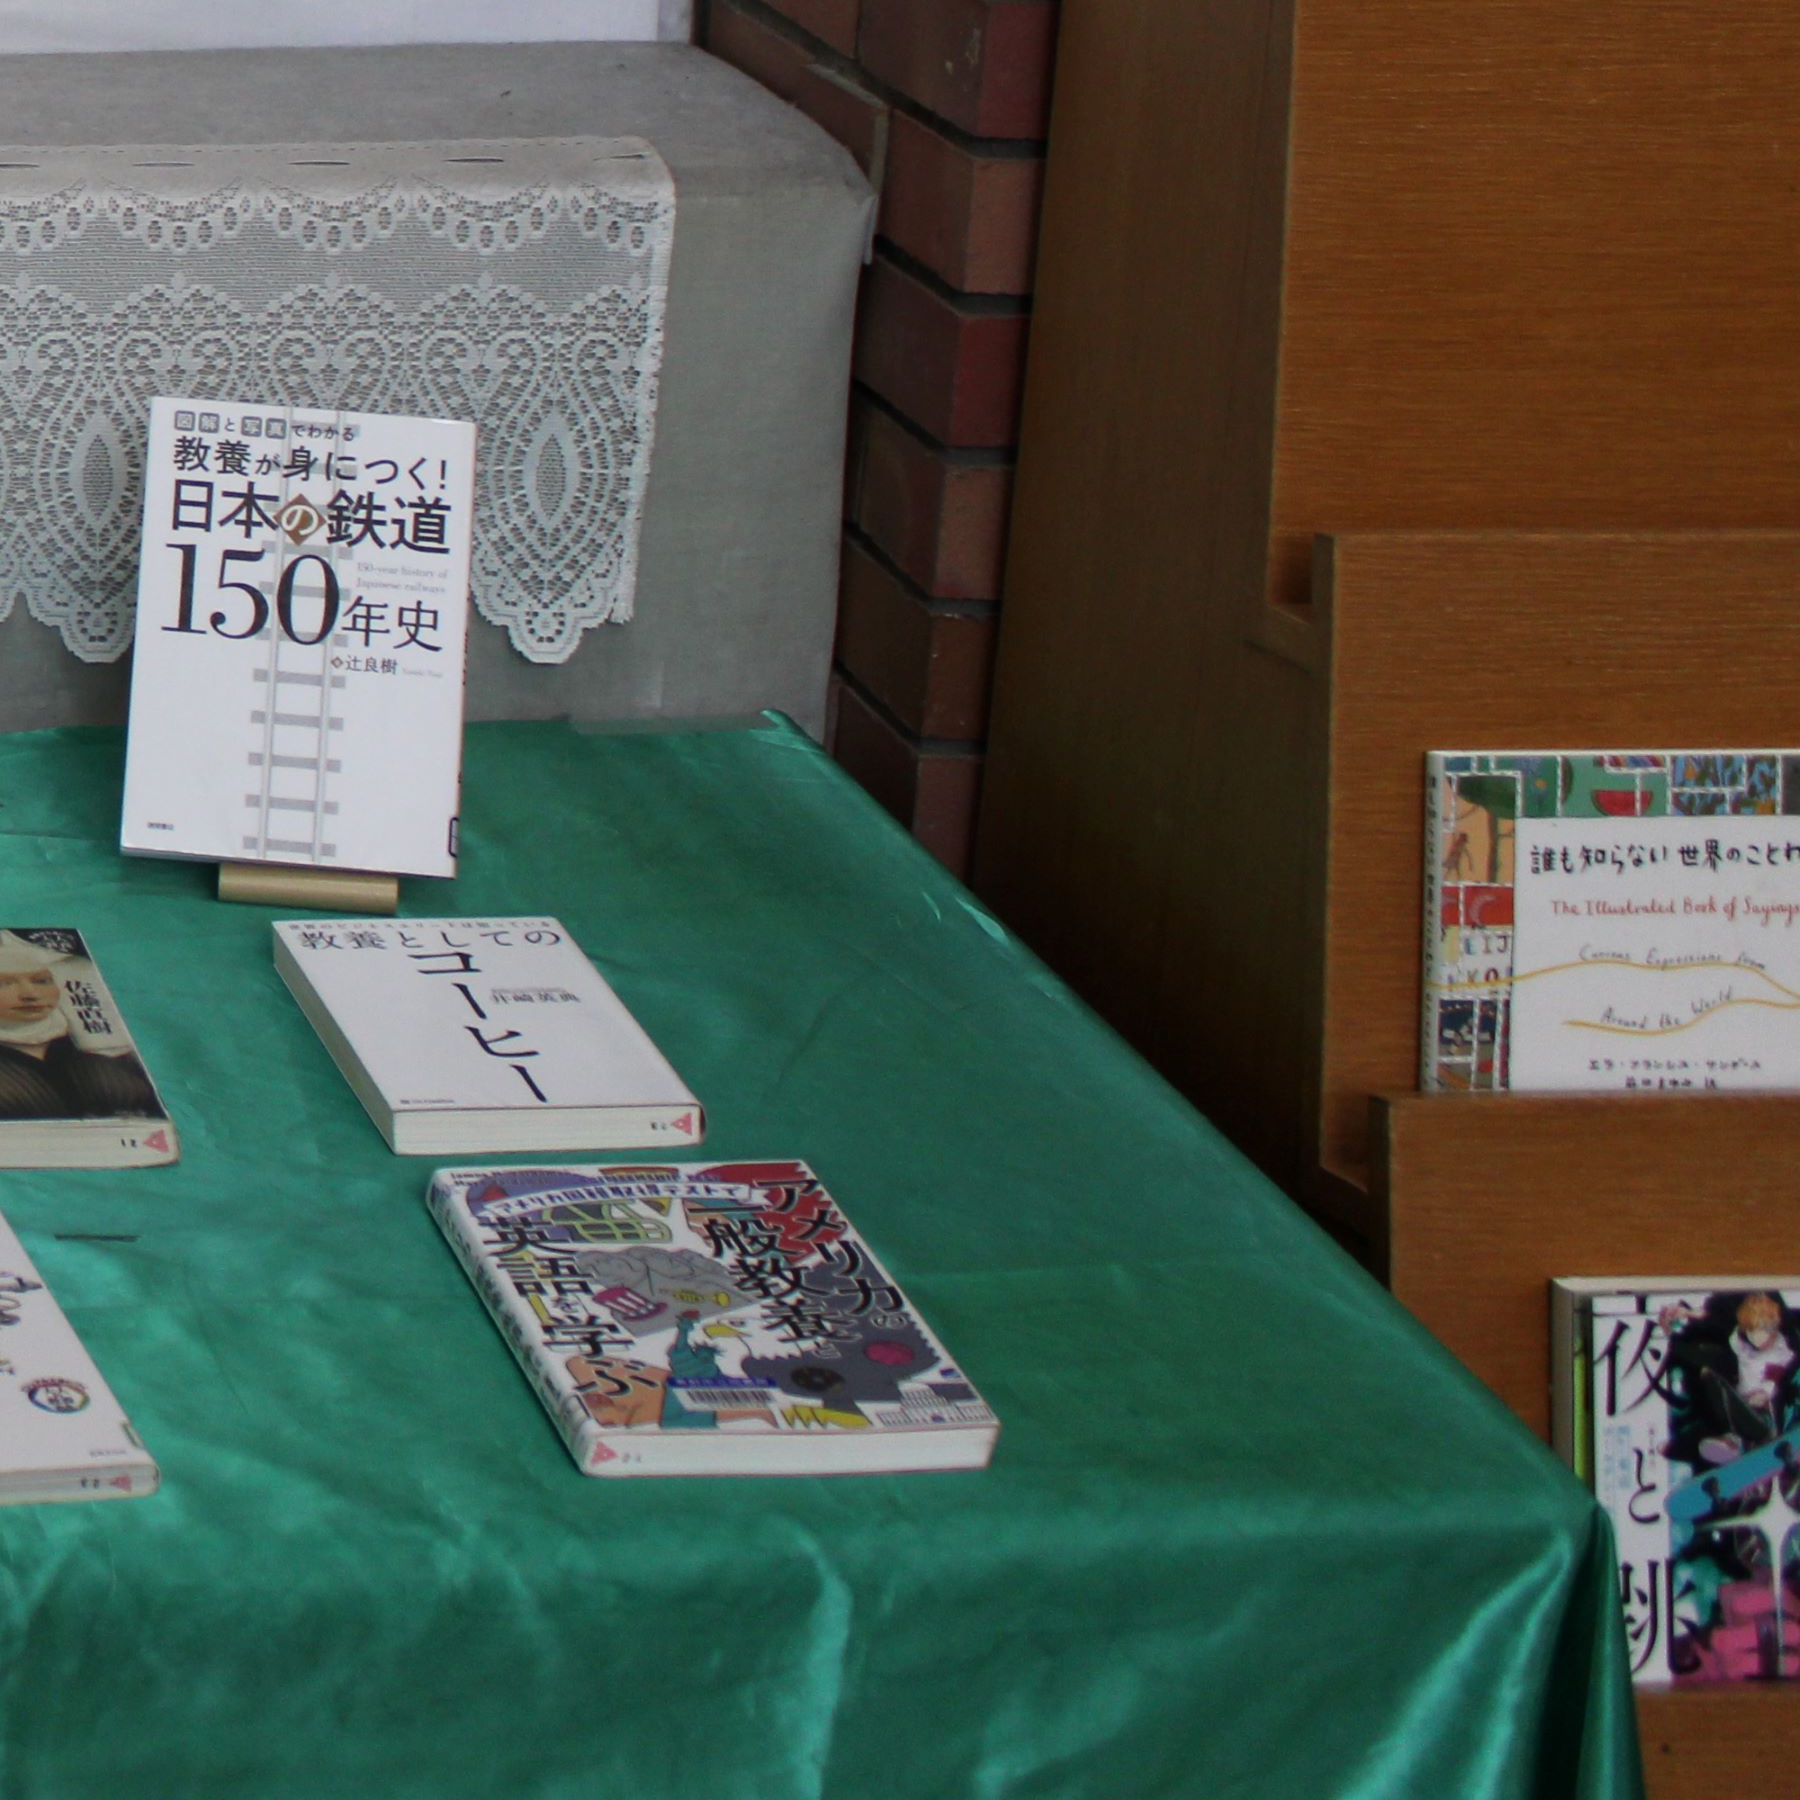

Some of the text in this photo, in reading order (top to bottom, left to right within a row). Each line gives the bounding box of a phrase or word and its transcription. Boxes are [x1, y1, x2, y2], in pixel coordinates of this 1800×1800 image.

[173, 437, 448, 491] 教養が身につく!
[171, 478, 452, 555] 日本の鉄道
[161, 543, 443, 653] 150年史
[1530, 844, 1668, 875] 誰も知らない
[300, 930, 561, 950] 教養としての
[1552, 896, 1800, 927] The Illustrated Book of Sayings
[408, 952, 549, 1103] コーヒー
[756, 1179, 907, 1330] アメリカの
[481, 1213, 660, 1397] 英語を学ぶ
